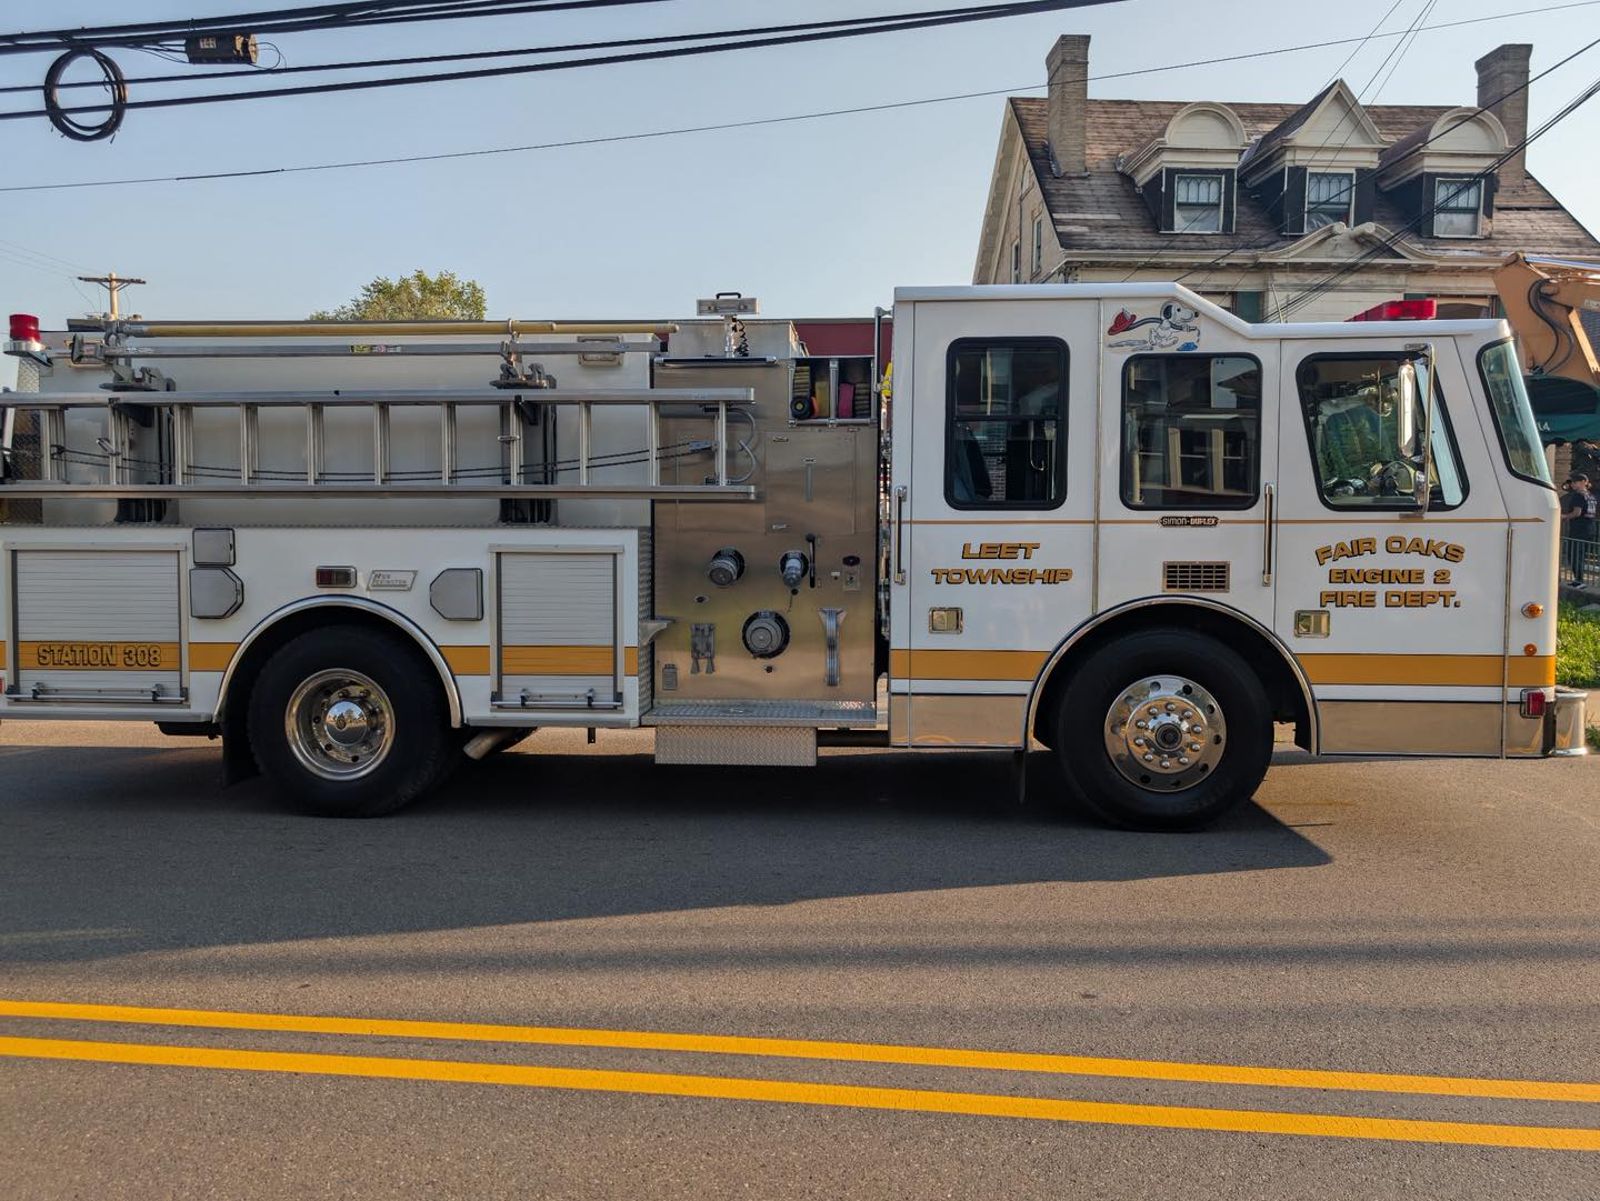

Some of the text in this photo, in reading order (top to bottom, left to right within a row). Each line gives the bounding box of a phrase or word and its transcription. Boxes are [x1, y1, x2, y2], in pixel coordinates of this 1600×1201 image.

[962, 543, 1040, 559] LEET
[1315, 536, 1465, 566] FAIR OAKS
[931, 568, 1073, 584] TOWNSHIP
[1329, 569, 1451, 584] ENGINE 2
[1320, 591, 1461, 608] FIRE DEPT.
[38, 643, 161, 667] STATION 308
